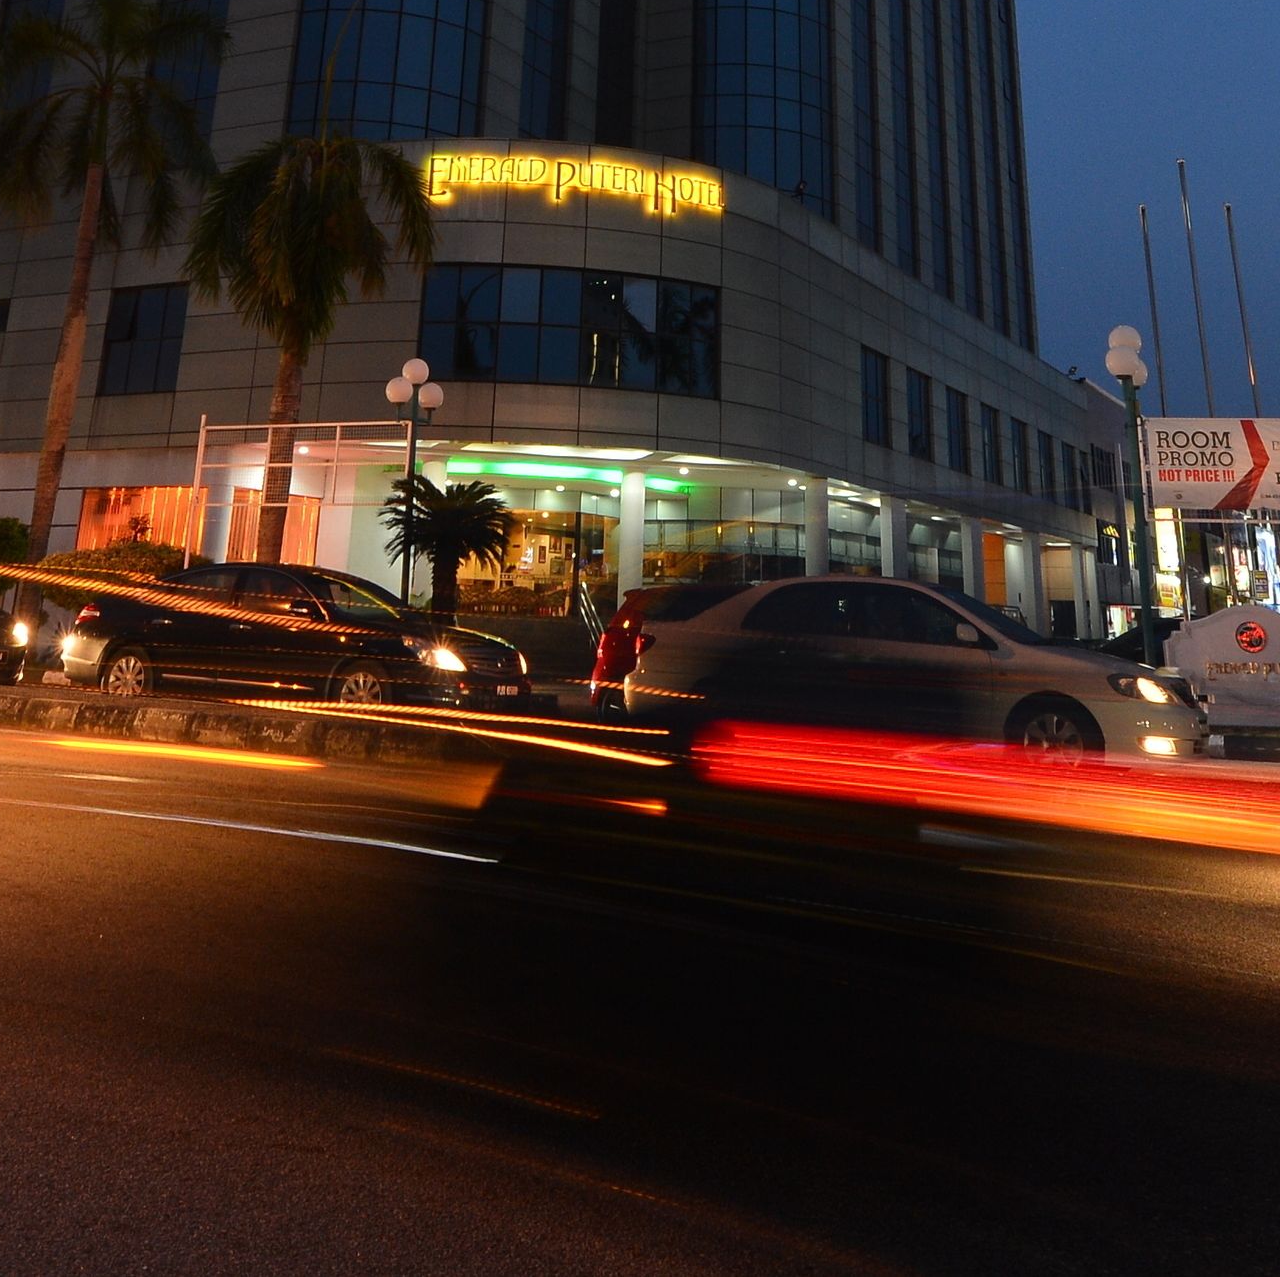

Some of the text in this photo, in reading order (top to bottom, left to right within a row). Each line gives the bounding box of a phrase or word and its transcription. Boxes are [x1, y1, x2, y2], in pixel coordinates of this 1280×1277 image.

[428, 156, 727, 213] EMERALD PUTERI HOTEL
[1155, 430, 1231, 449] ROOM
[1157, 450, 1235, 467] PROMO
[1158, 469, 1182, 482] HOT
[1184, 469, 1220, 482] PRICE
